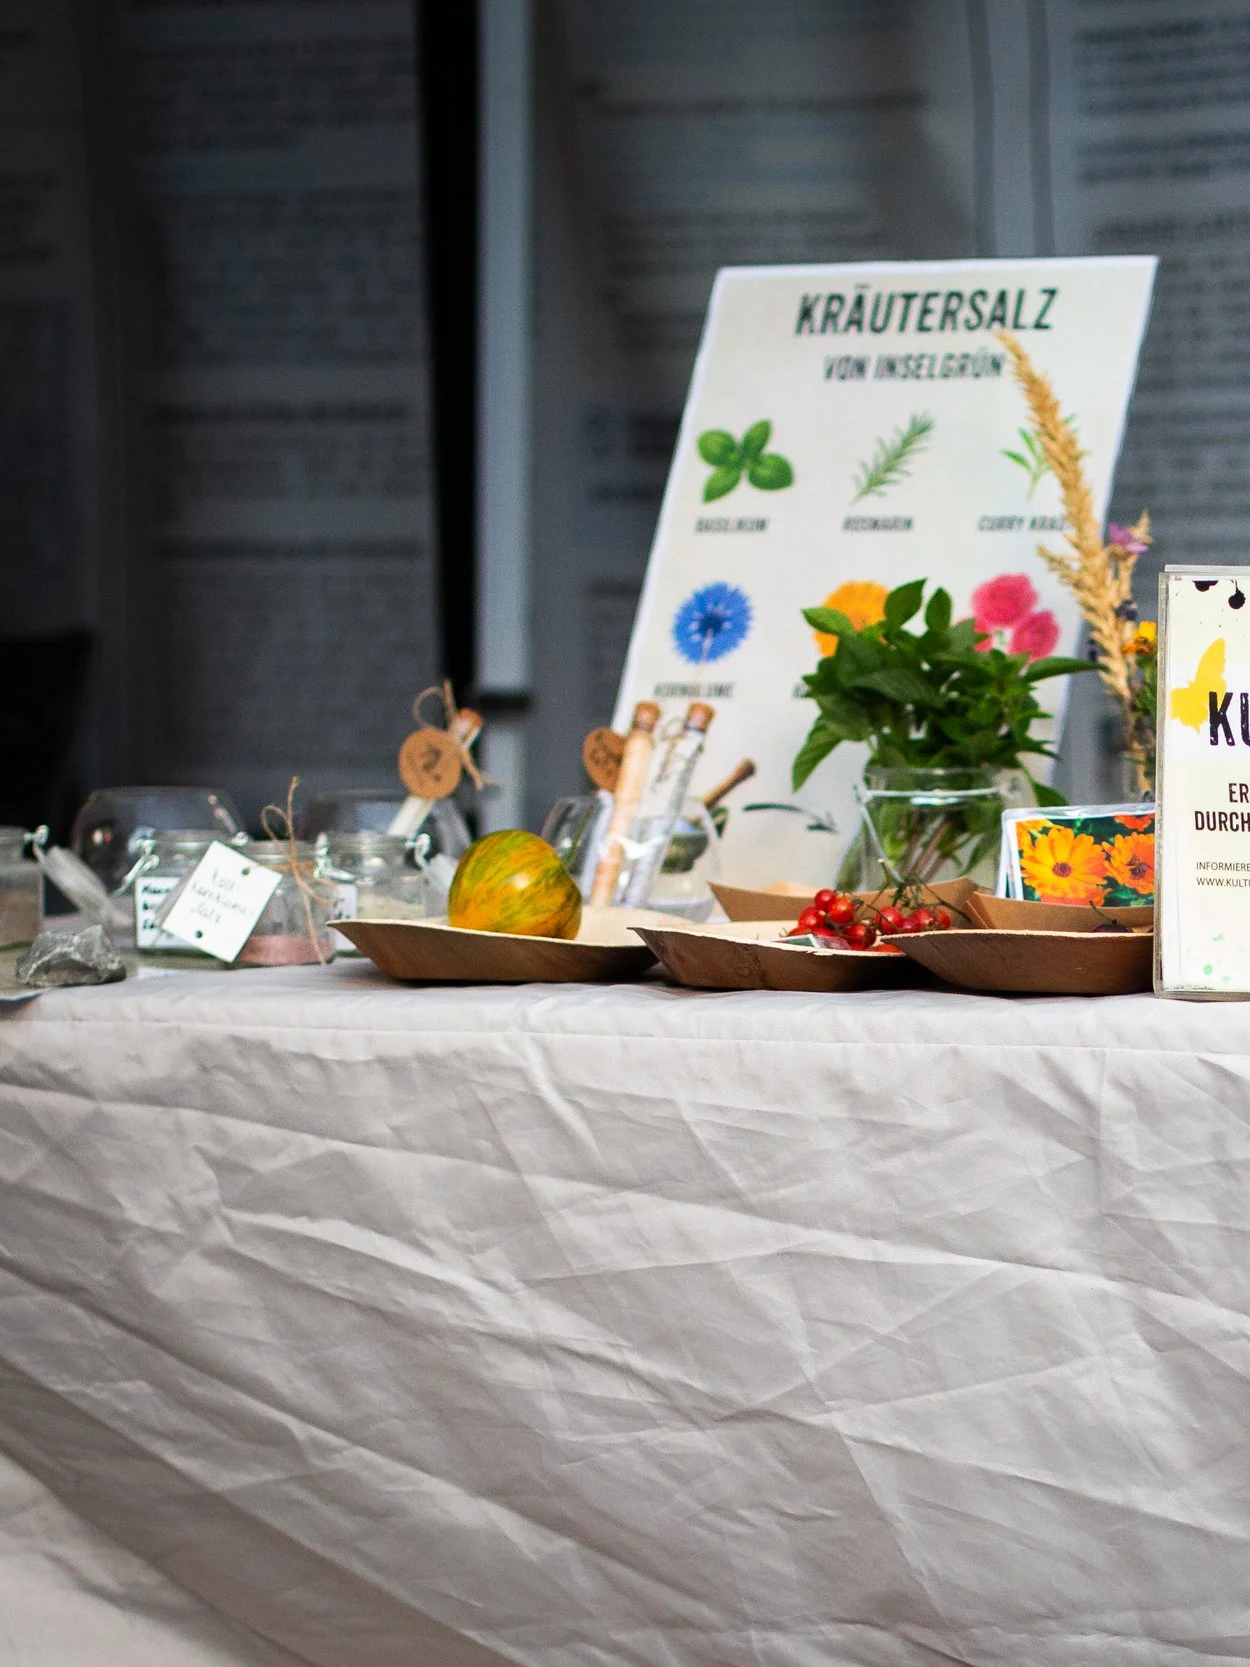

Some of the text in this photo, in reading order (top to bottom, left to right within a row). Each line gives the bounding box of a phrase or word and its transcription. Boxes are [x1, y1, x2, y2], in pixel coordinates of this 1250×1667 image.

[795, 283, 1059, 335] KRÄUTERSALZ
[824, 347, 1006, 380] VON INSELGRÜN
[1196, 862, 1250, 872] INFORMIERE
